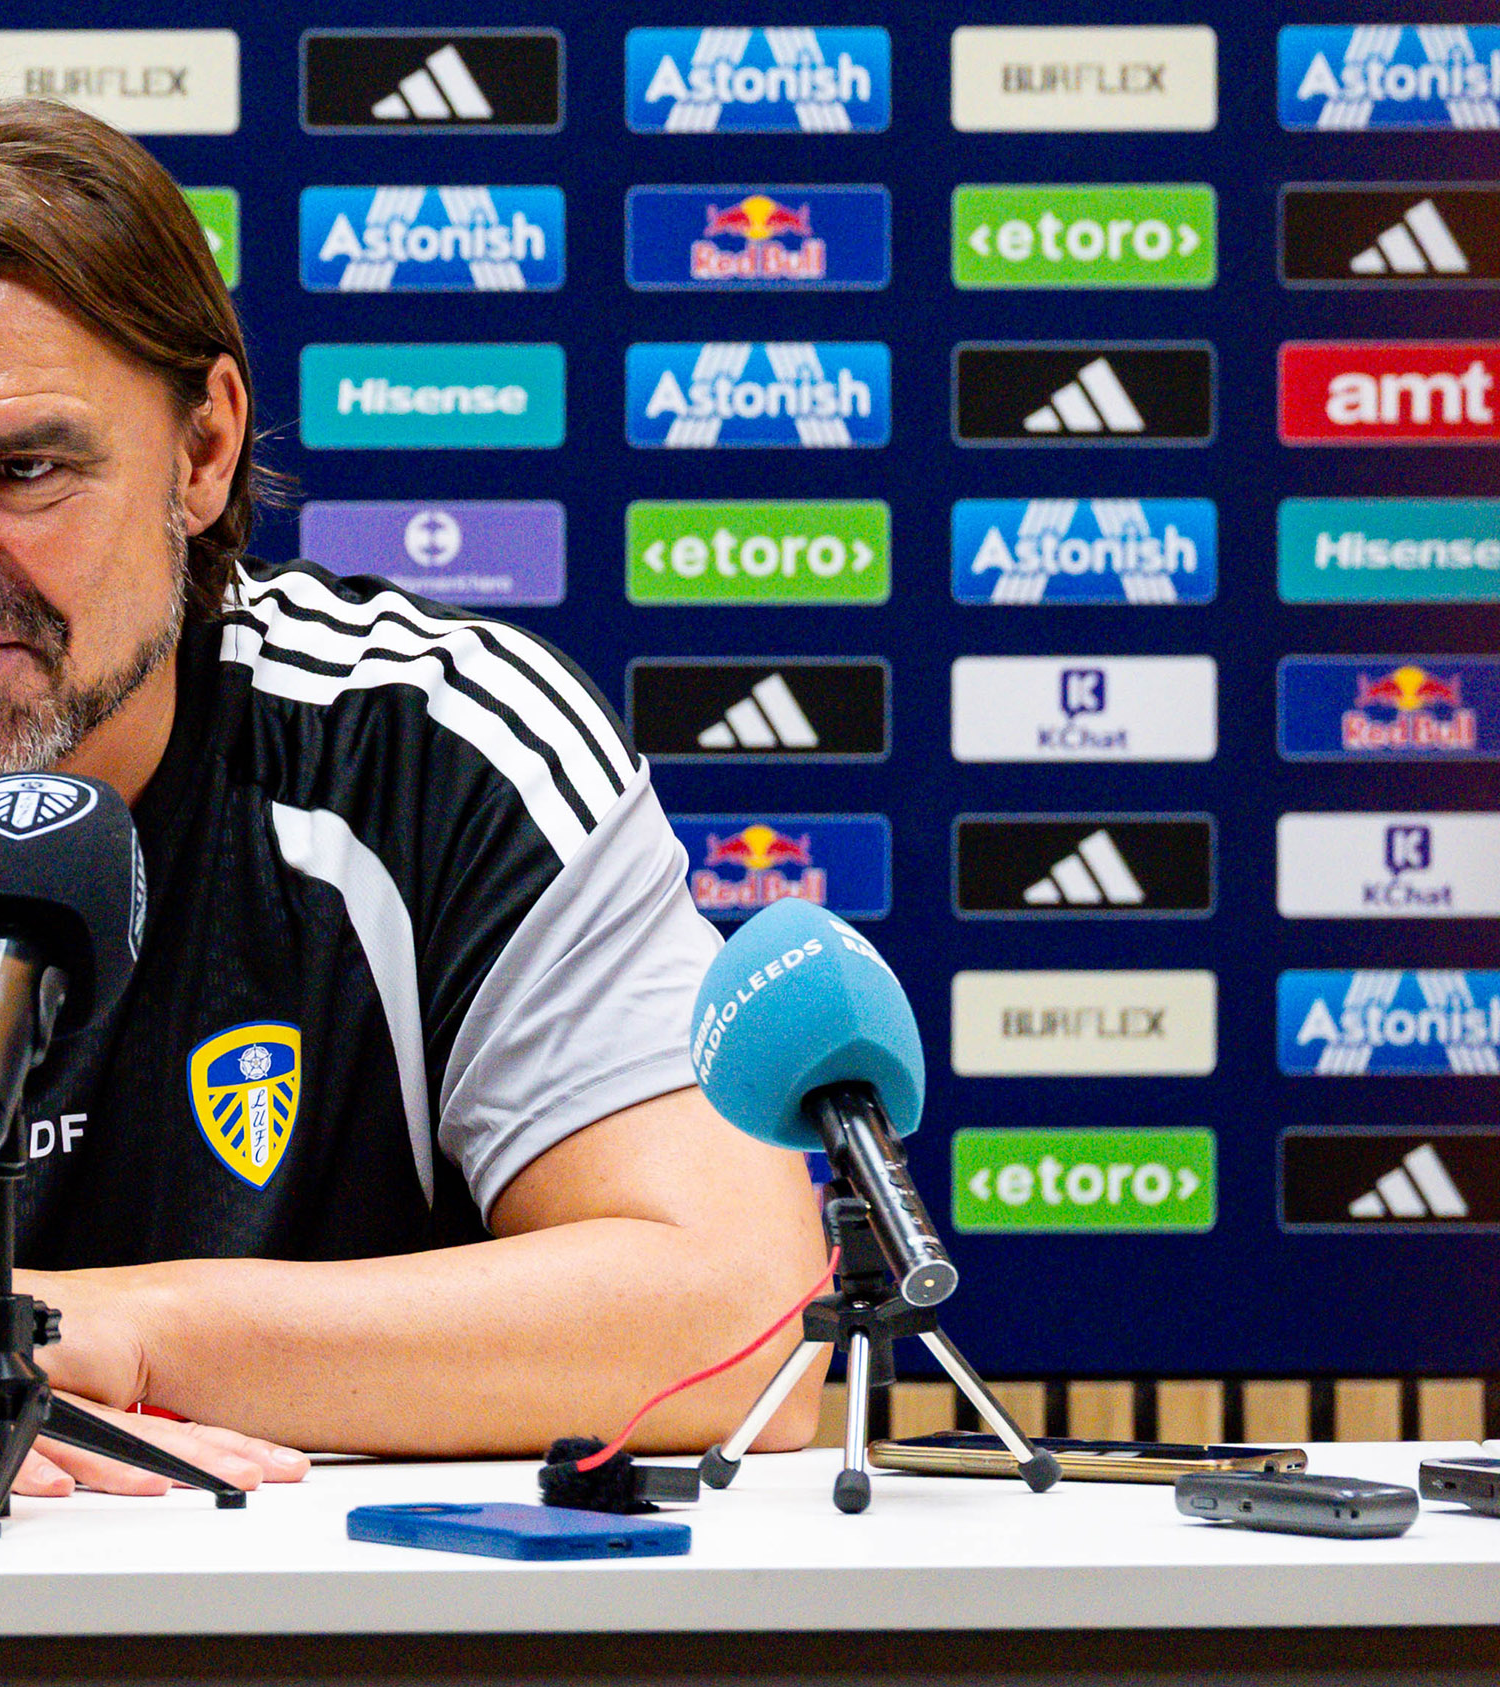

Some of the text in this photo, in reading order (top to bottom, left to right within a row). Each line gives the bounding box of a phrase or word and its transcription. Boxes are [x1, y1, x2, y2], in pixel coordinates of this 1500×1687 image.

[25, 67, 187, 97] BURFLEX
[646, 53, 871, 104] Astonish
[1002, 64, 1165, 94] BURFLEX
[319, 211, 545, 262] Astonish
[690, 240, 756, 279] Red
[338, 378, 527, 414] Hisense
[646, 369, 871, 420] Astonish
[1326, 362, 1492, 424] amt
[972, 525, 1197, 575] Astonish
[1315, 532, 1500, 569] Hisense
[1039, 726, 1127, 749] KChat
[1342, 710, 1407, 749] Red
[1364, 884, 1452, 907] KChat
[700, 938, 823, 1084] RADIO LEEDS
[1002, 1008, 1165, 1038] BURFLEX
[29, 1113, 87, 1159] DF
[250, 1089, 267, 1163] LUFC
